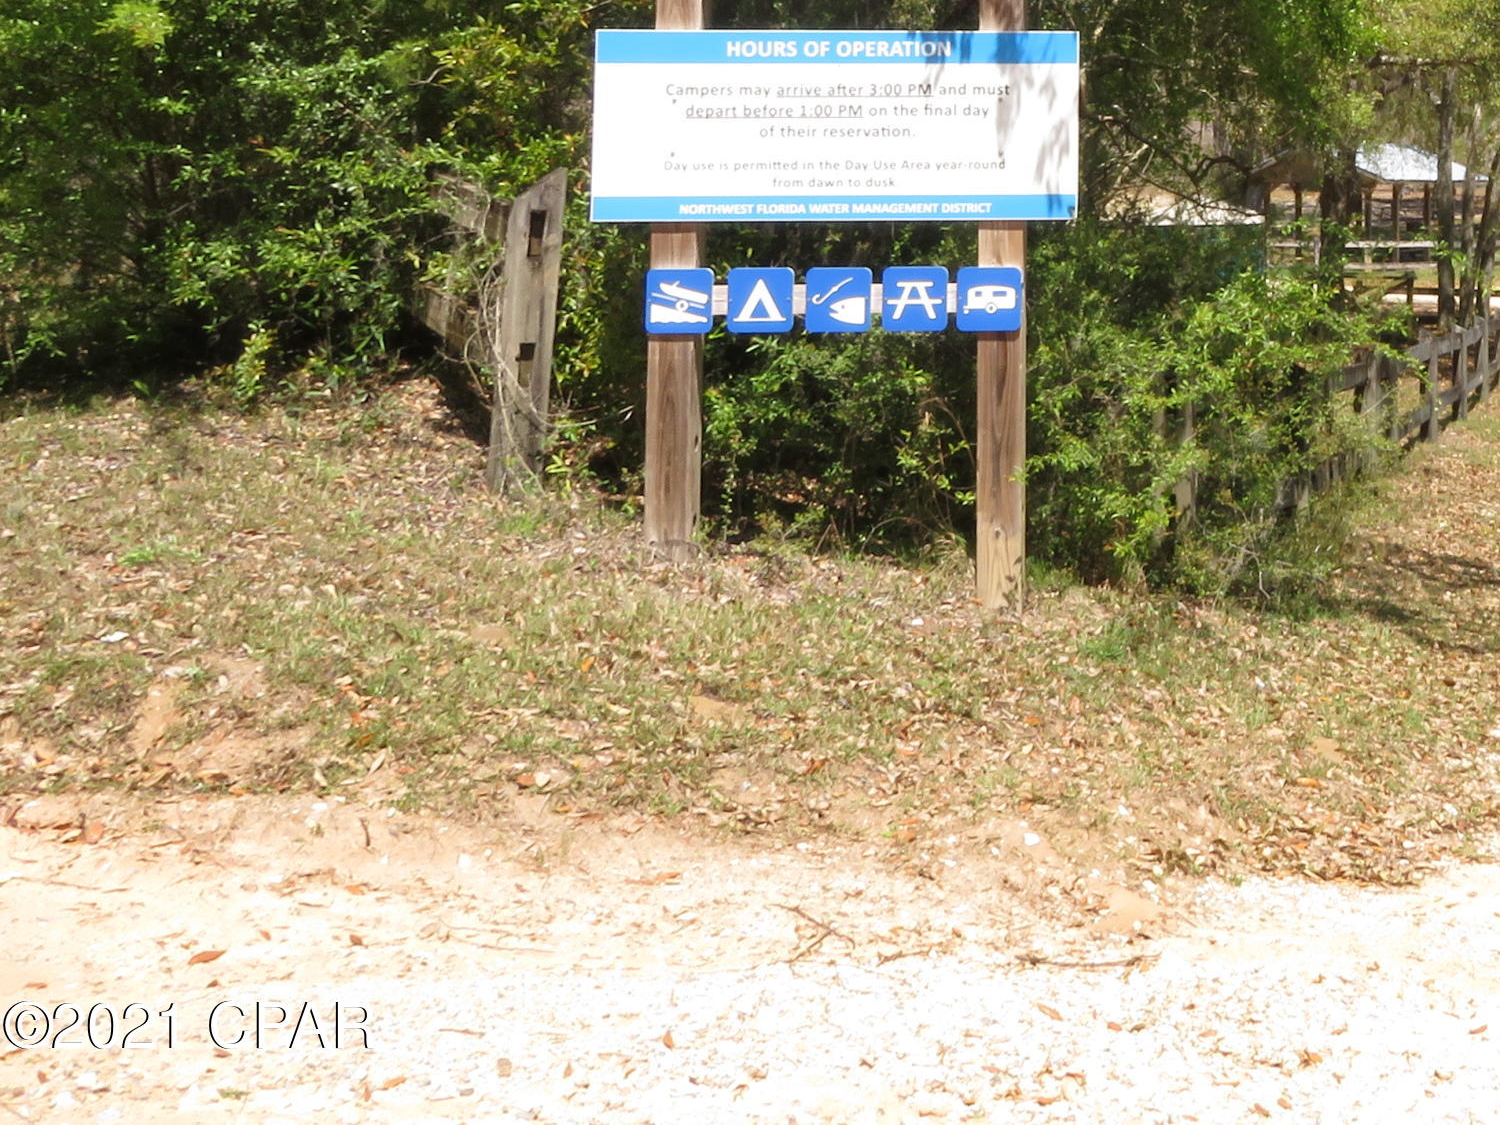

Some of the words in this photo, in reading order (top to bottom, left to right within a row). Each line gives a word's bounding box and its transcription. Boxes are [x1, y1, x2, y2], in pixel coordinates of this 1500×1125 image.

[727, 41, 798, 58] HOURS
[804, 41, 829, 58] OF
[836, 41, 952, 58] OPERATION
[666, 83, 733, 99] Campers
[739, 85, 770, 99] may
[777, 84, 822, 97] arrive
[828, 83, 863, 97] after
[869, 83, 901, 96] 3:00
[907, 83, 932, 96] PM
[939, 83, 967, 96] and
[973, 84, 1010, 97] must
[686, 104, 737, 120] depart
[743, 104, 794, 117] before
[800, 104, 832, 117] 1:00
[838, 104, 863, 117] PM
[869, 106, 888, 117] on
[895, 104, 918, 117] the
[924, 103, 957, 117] final
[963, 104, 989, 119] day
[760, 125, 776, 138] of
[781, 125, 817, 138] their
[823, 125, 915, 138] reservation.
[664, 160, 688, 173] Day
[692, 162, 714, 171] use
[720, 160, 729, 171] is
[734, 160, 798, 173] permitted
[803, 160, 814, 171] in
[819, 159, 840, 171] the
[845, 160, 870, 173] Day
[874, 160, 896, 171] Use
[901, 160, 930, 171] Area
[936, 159, 1005, 173] year-round
[773, 177, 803, 188] from
[808, 177, 843, 188] dawn
[847, 178, 861, 188] to
[679, 203, 753, 215] NORTHWEST
[757, 203, 806, 215] FLORIDA
[809, 203, 849, 214] WATER
[852, 203, 938, 214] MANAGEMENT
[941, 202, 992, 214] DISTRICT
